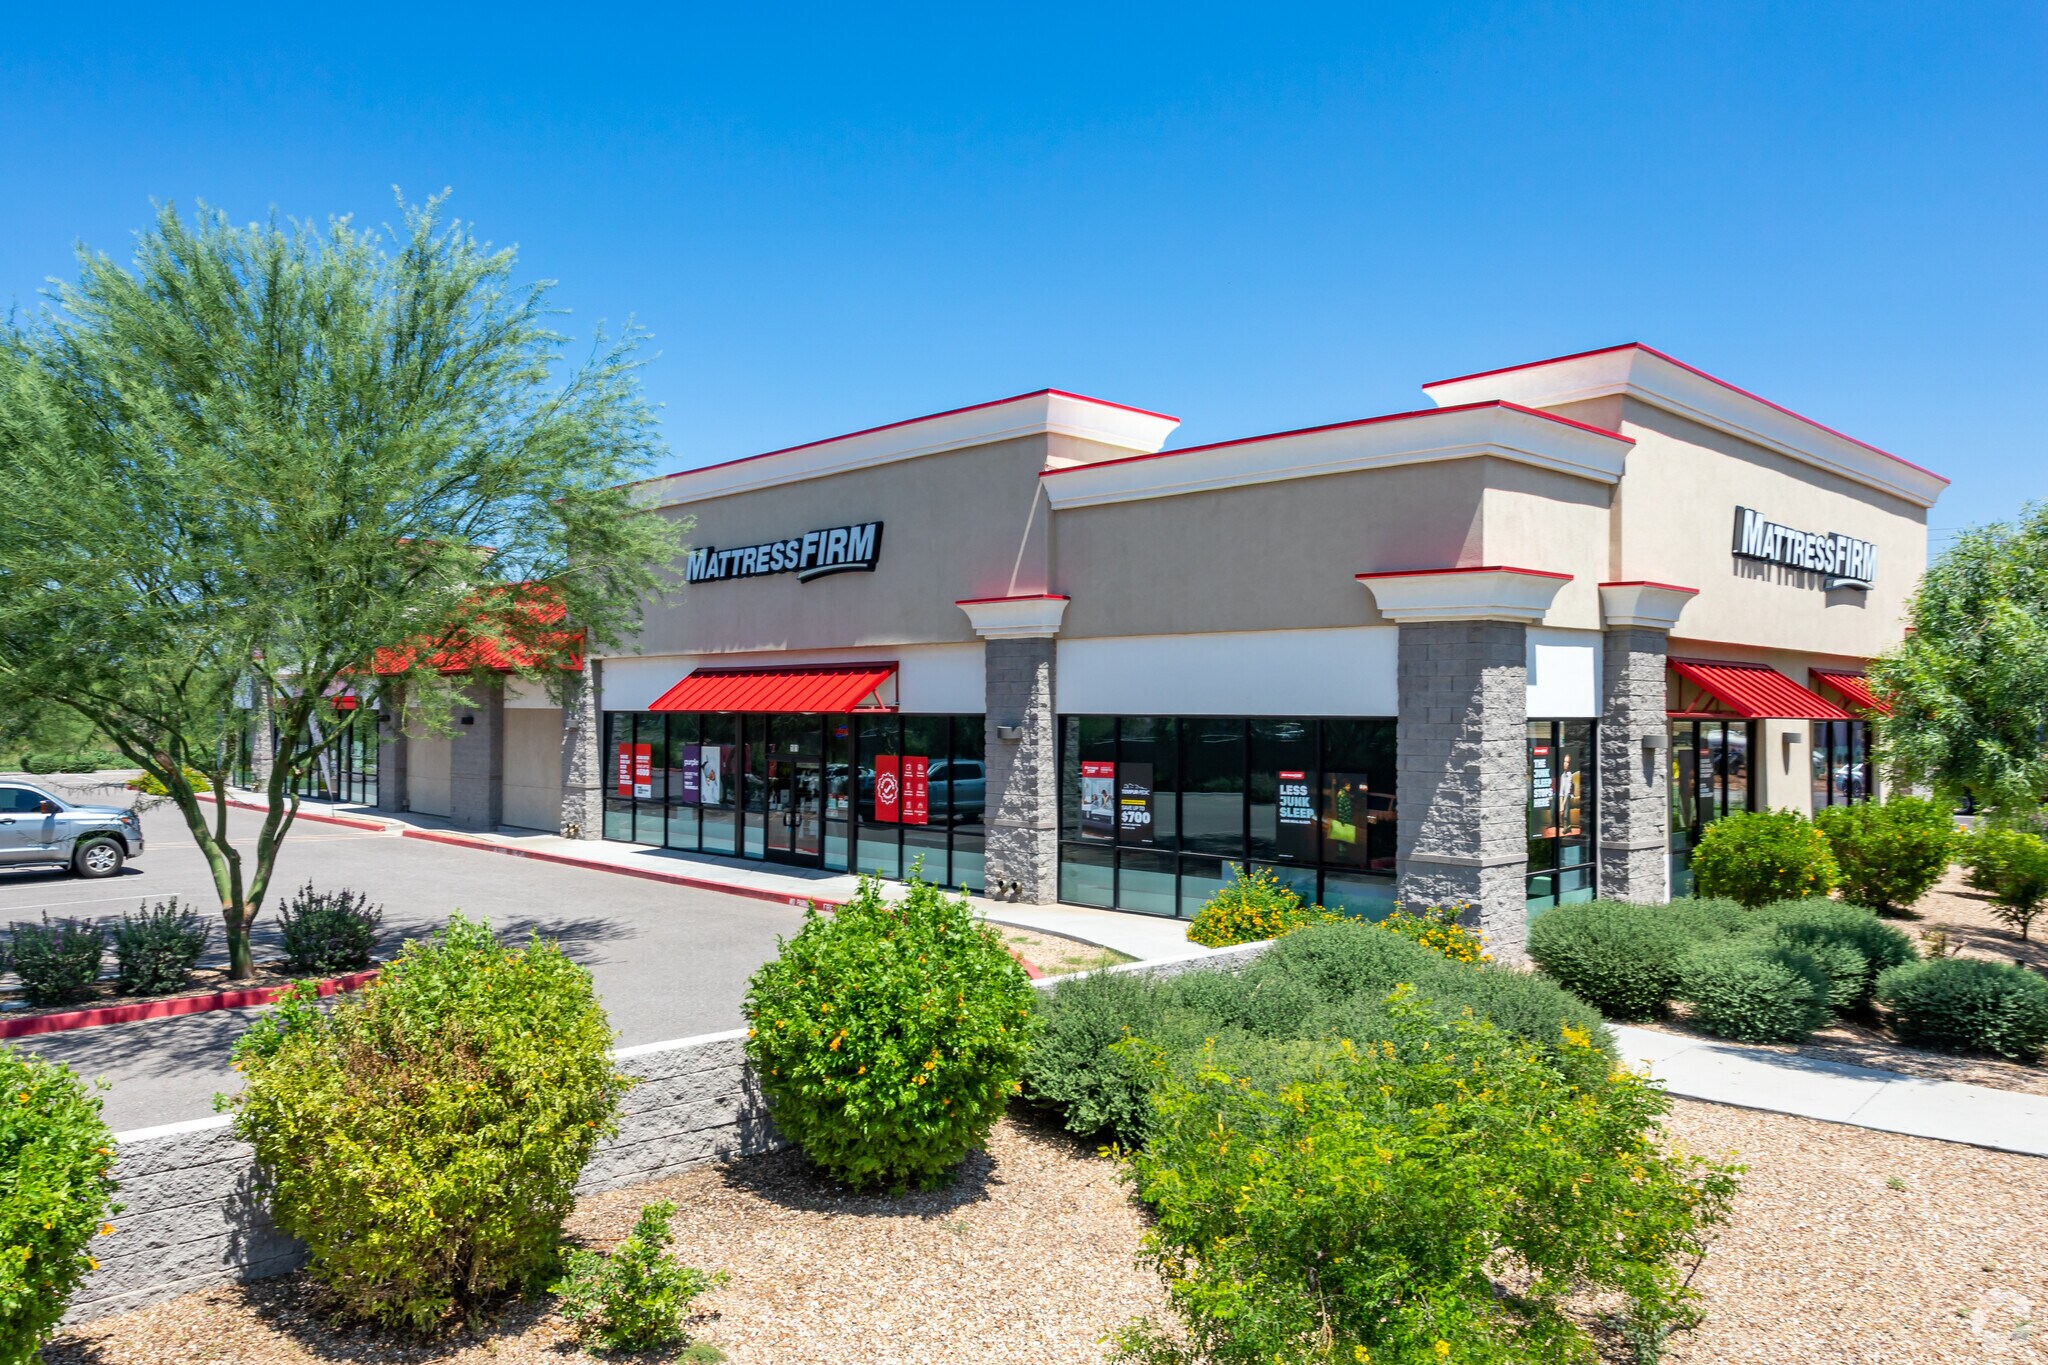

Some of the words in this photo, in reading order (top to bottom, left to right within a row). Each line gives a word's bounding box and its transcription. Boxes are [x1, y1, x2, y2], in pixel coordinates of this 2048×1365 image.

[1533, 759, 1546, 768] THE
[1533, 778, 1552, 788] SLEEP
[1280, 785, 1308, 796] LESS
[1280, 796, 1310, 807] JUNK
[1121, 811, 1151, 823] $700
[1280, 807, 1314, 818] SLEEP
